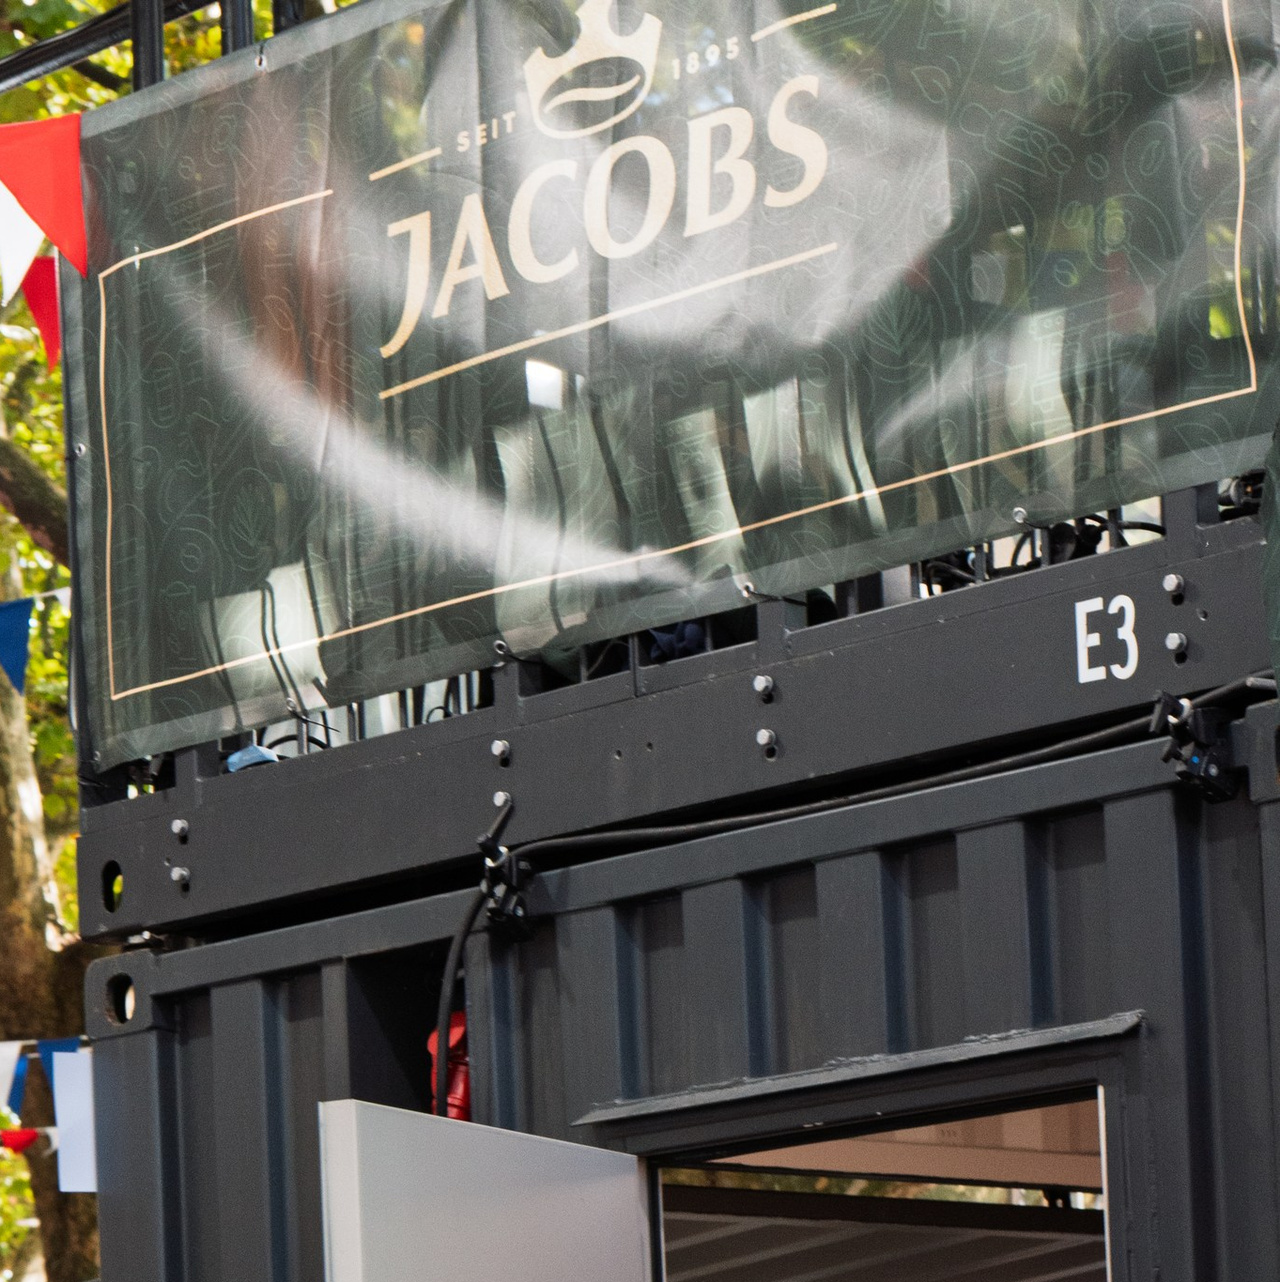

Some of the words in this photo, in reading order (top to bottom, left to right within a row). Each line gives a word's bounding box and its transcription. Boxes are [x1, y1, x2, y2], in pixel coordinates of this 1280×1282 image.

[671, 36, 740, 81] 1895
[456, 110, 517, 153] SEIT
[379, 73, 829, 360] JACOBS
[1074, 594, 1139, 684] E3
